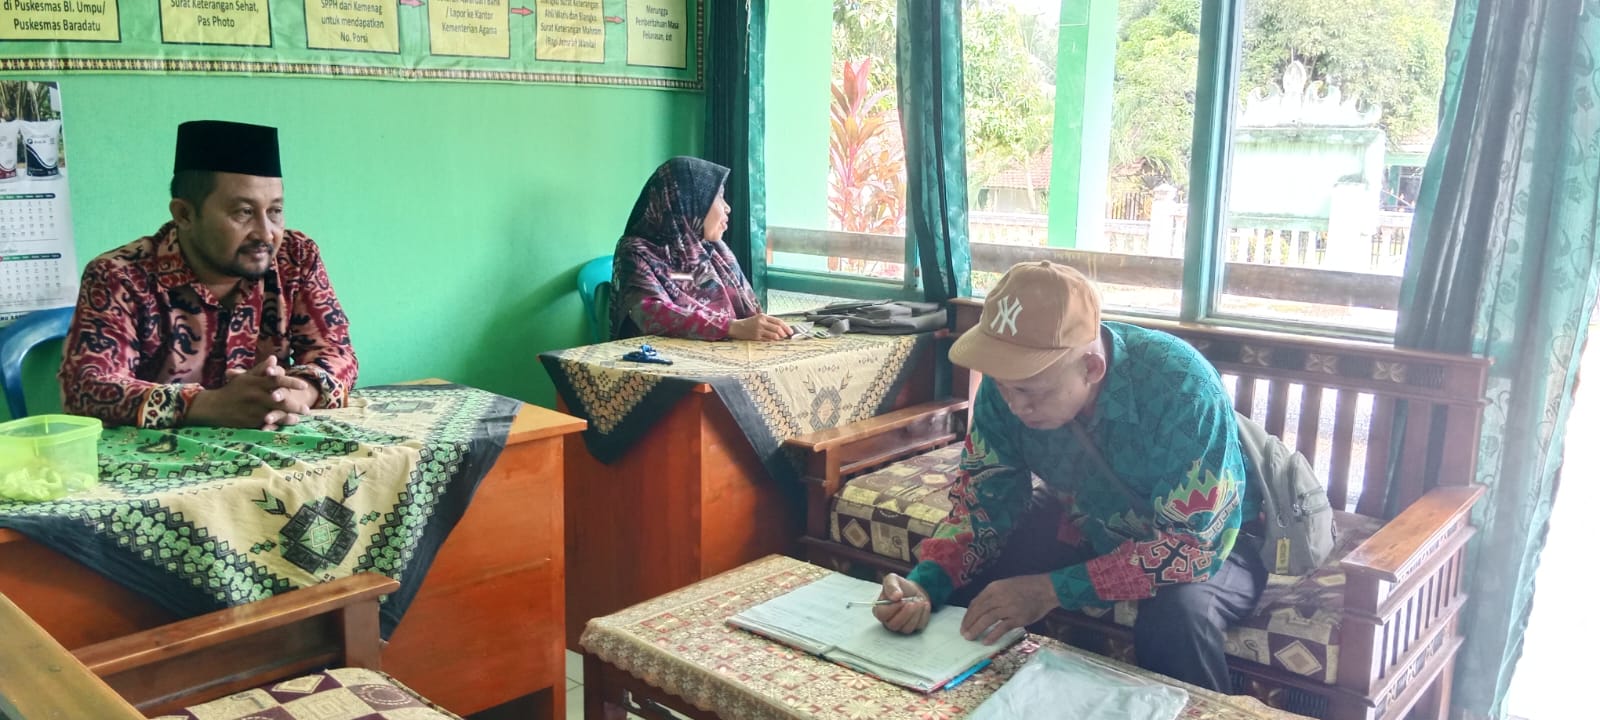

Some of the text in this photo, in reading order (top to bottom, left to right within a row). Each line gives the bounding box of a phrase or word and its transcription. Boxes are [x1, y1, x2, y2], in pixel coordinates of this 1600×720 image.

[3, 0, 106, 15] di Puskesmas Bl. Umpu/
[171, 0, 259, 13] Surat Keterangan Sehat,
[13, 18, 101, 31] Puskesmas Baradatu
[197, 15, 235, 28] Pas Photo
[321, 16, 384, 29] untuk mendapatkan
[340, 32, 368, 43] No. Porsi
[990, 295, 1023, 337] NY
